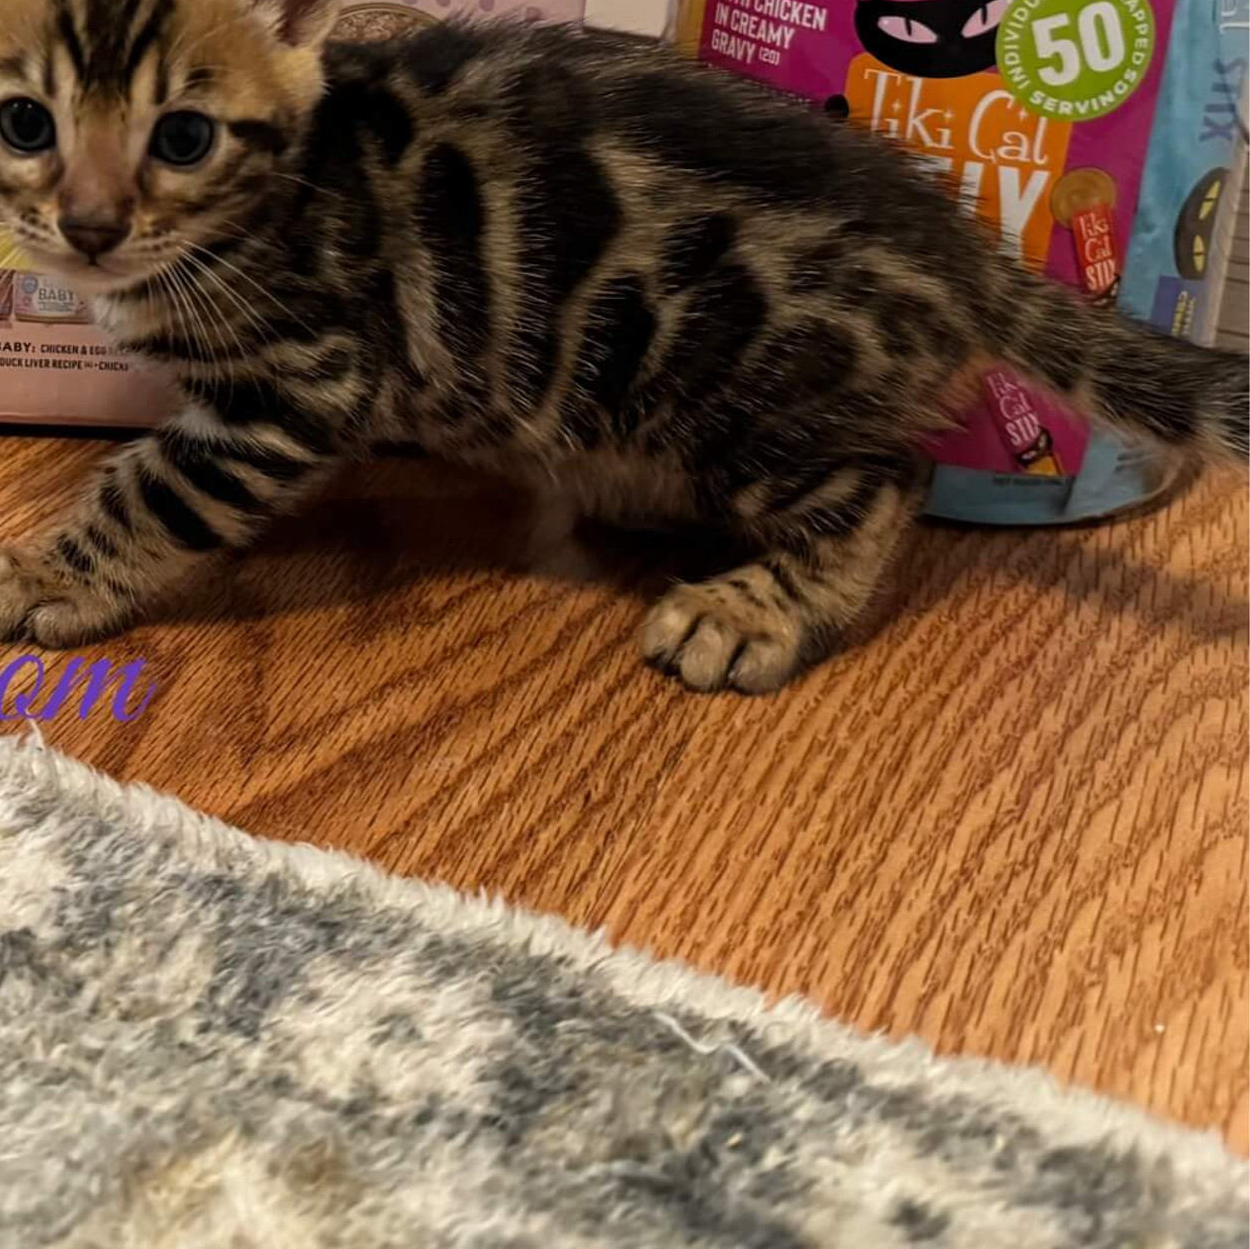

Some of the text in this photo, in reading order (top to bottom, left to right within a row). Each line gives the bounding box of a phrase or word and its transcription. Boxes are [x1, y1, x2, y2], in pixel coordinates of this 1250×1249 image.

[711, 28, 757, 65] GRAVY
[714, 2, 796, 50] IN CREAMY
[1031, 1, 1125, 86] 50
[864, 68, 956, 150] Tiki
[1029, 68, 1137, 115] SERVINGS
[0, 357, 23, 368] DUCK
[25, 358, 50, 369] LIVER
[52, 359, 83, 371] RECIPE
[40, 343, 79, 355] CHICKEN
